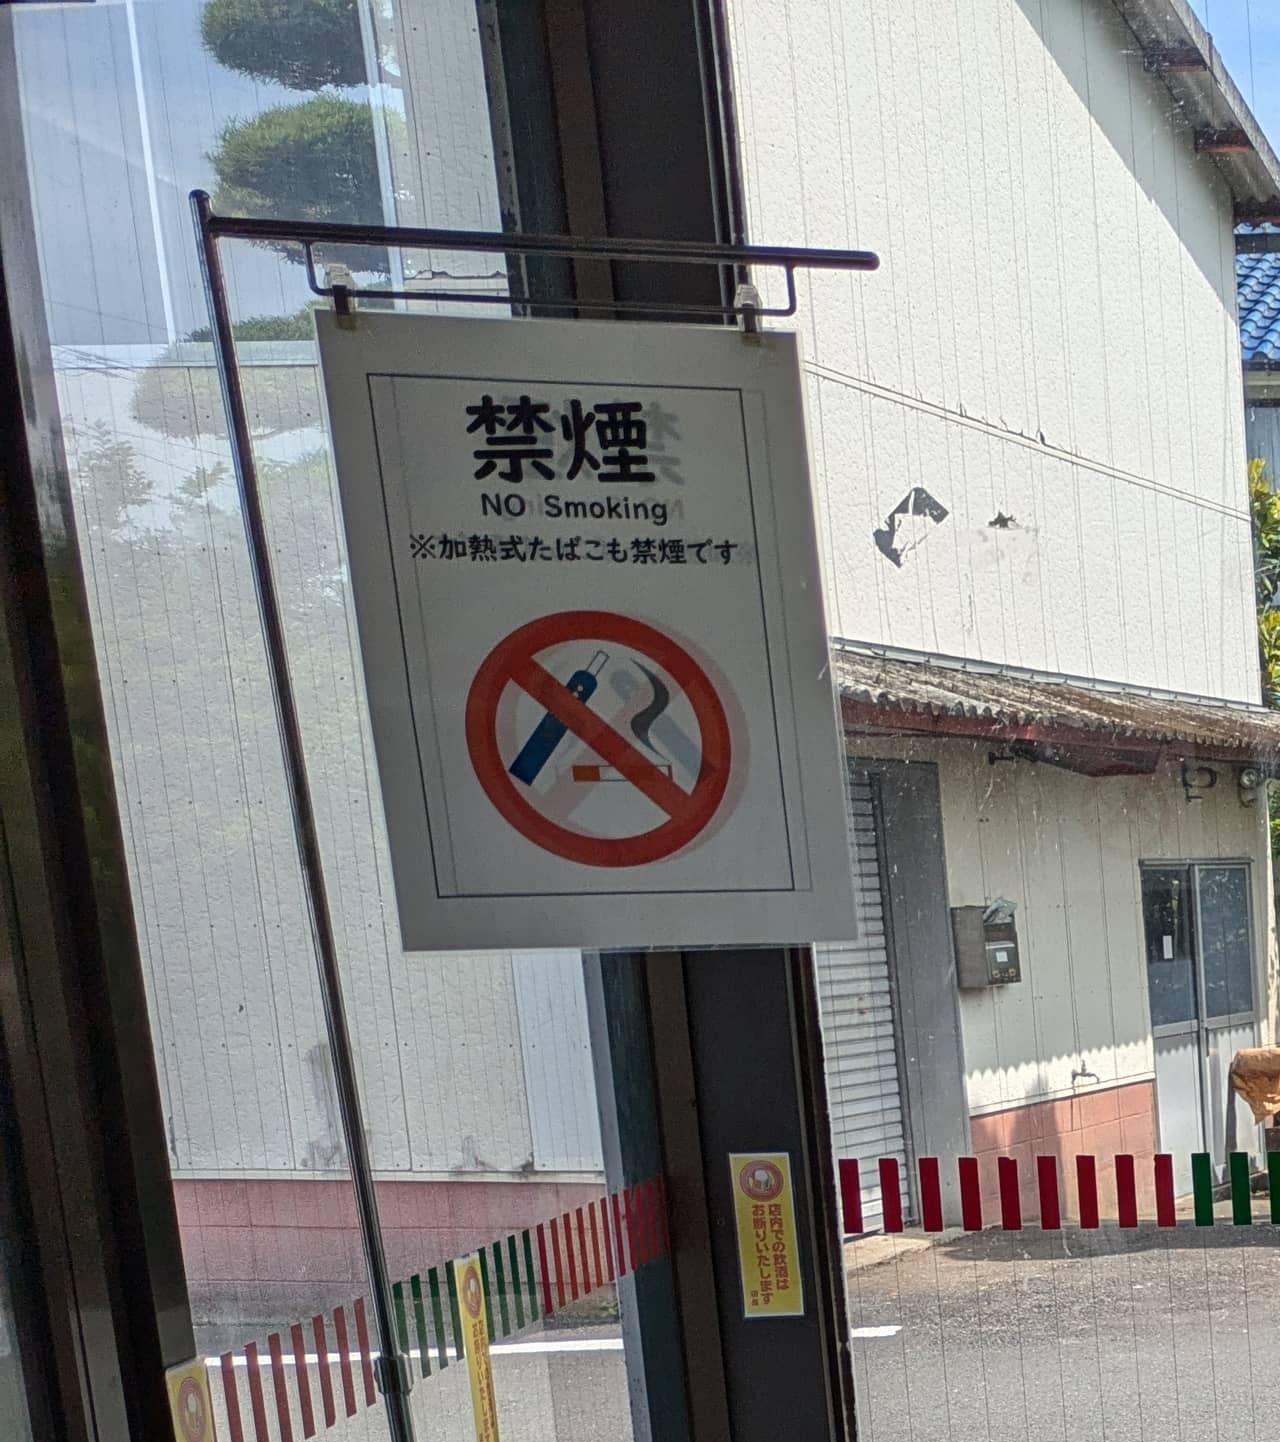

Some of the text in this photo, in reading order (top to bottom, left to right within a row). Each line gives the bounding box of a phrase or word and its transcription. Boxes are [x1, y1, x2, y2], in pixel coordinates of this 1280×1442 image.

[466, 394, 656, 483] 禁煙
[409, 533, 739, 566] ※加熱式たばこも禁煙です
[480, 493, 668, 526] NO Smoking
[751, 1204, 774, 1306] お断りいたします
[767, 1203, 789, 1291] 店内での飲酒は
